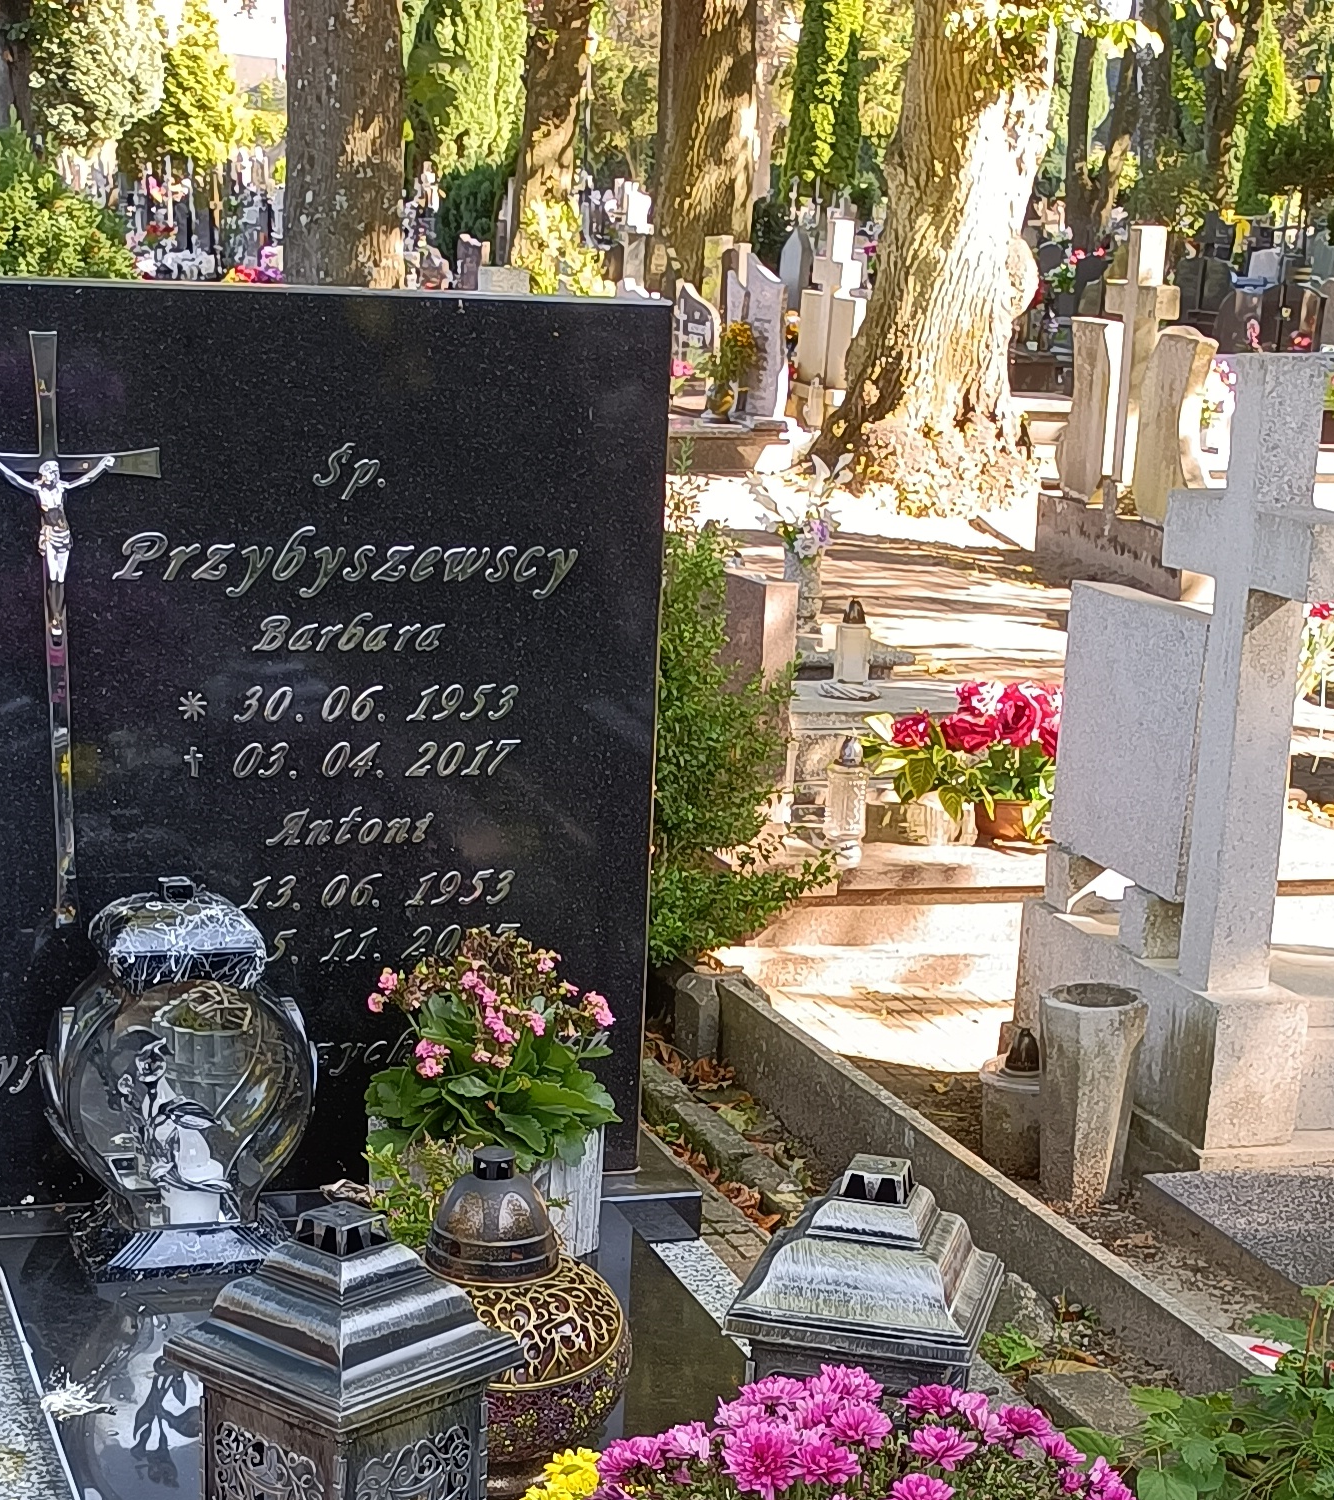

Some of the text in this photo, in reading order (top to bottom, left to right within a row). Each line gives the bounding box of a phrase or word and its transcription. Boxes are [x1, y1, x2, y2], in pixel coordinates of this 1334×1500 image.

[312, 442, 387, 501] Śp.
[112, 525, 579, 600] Przybyszewscy
[252, 612, 446, 653] Barbara
[233, 683, 520, 723] 30. 06. 1953
[232, 739, 522, 780] 03. 04. 2017
[265, 806, 435, 847] Antoni
[238, 868, 517, 911] 13. 06. 1953
